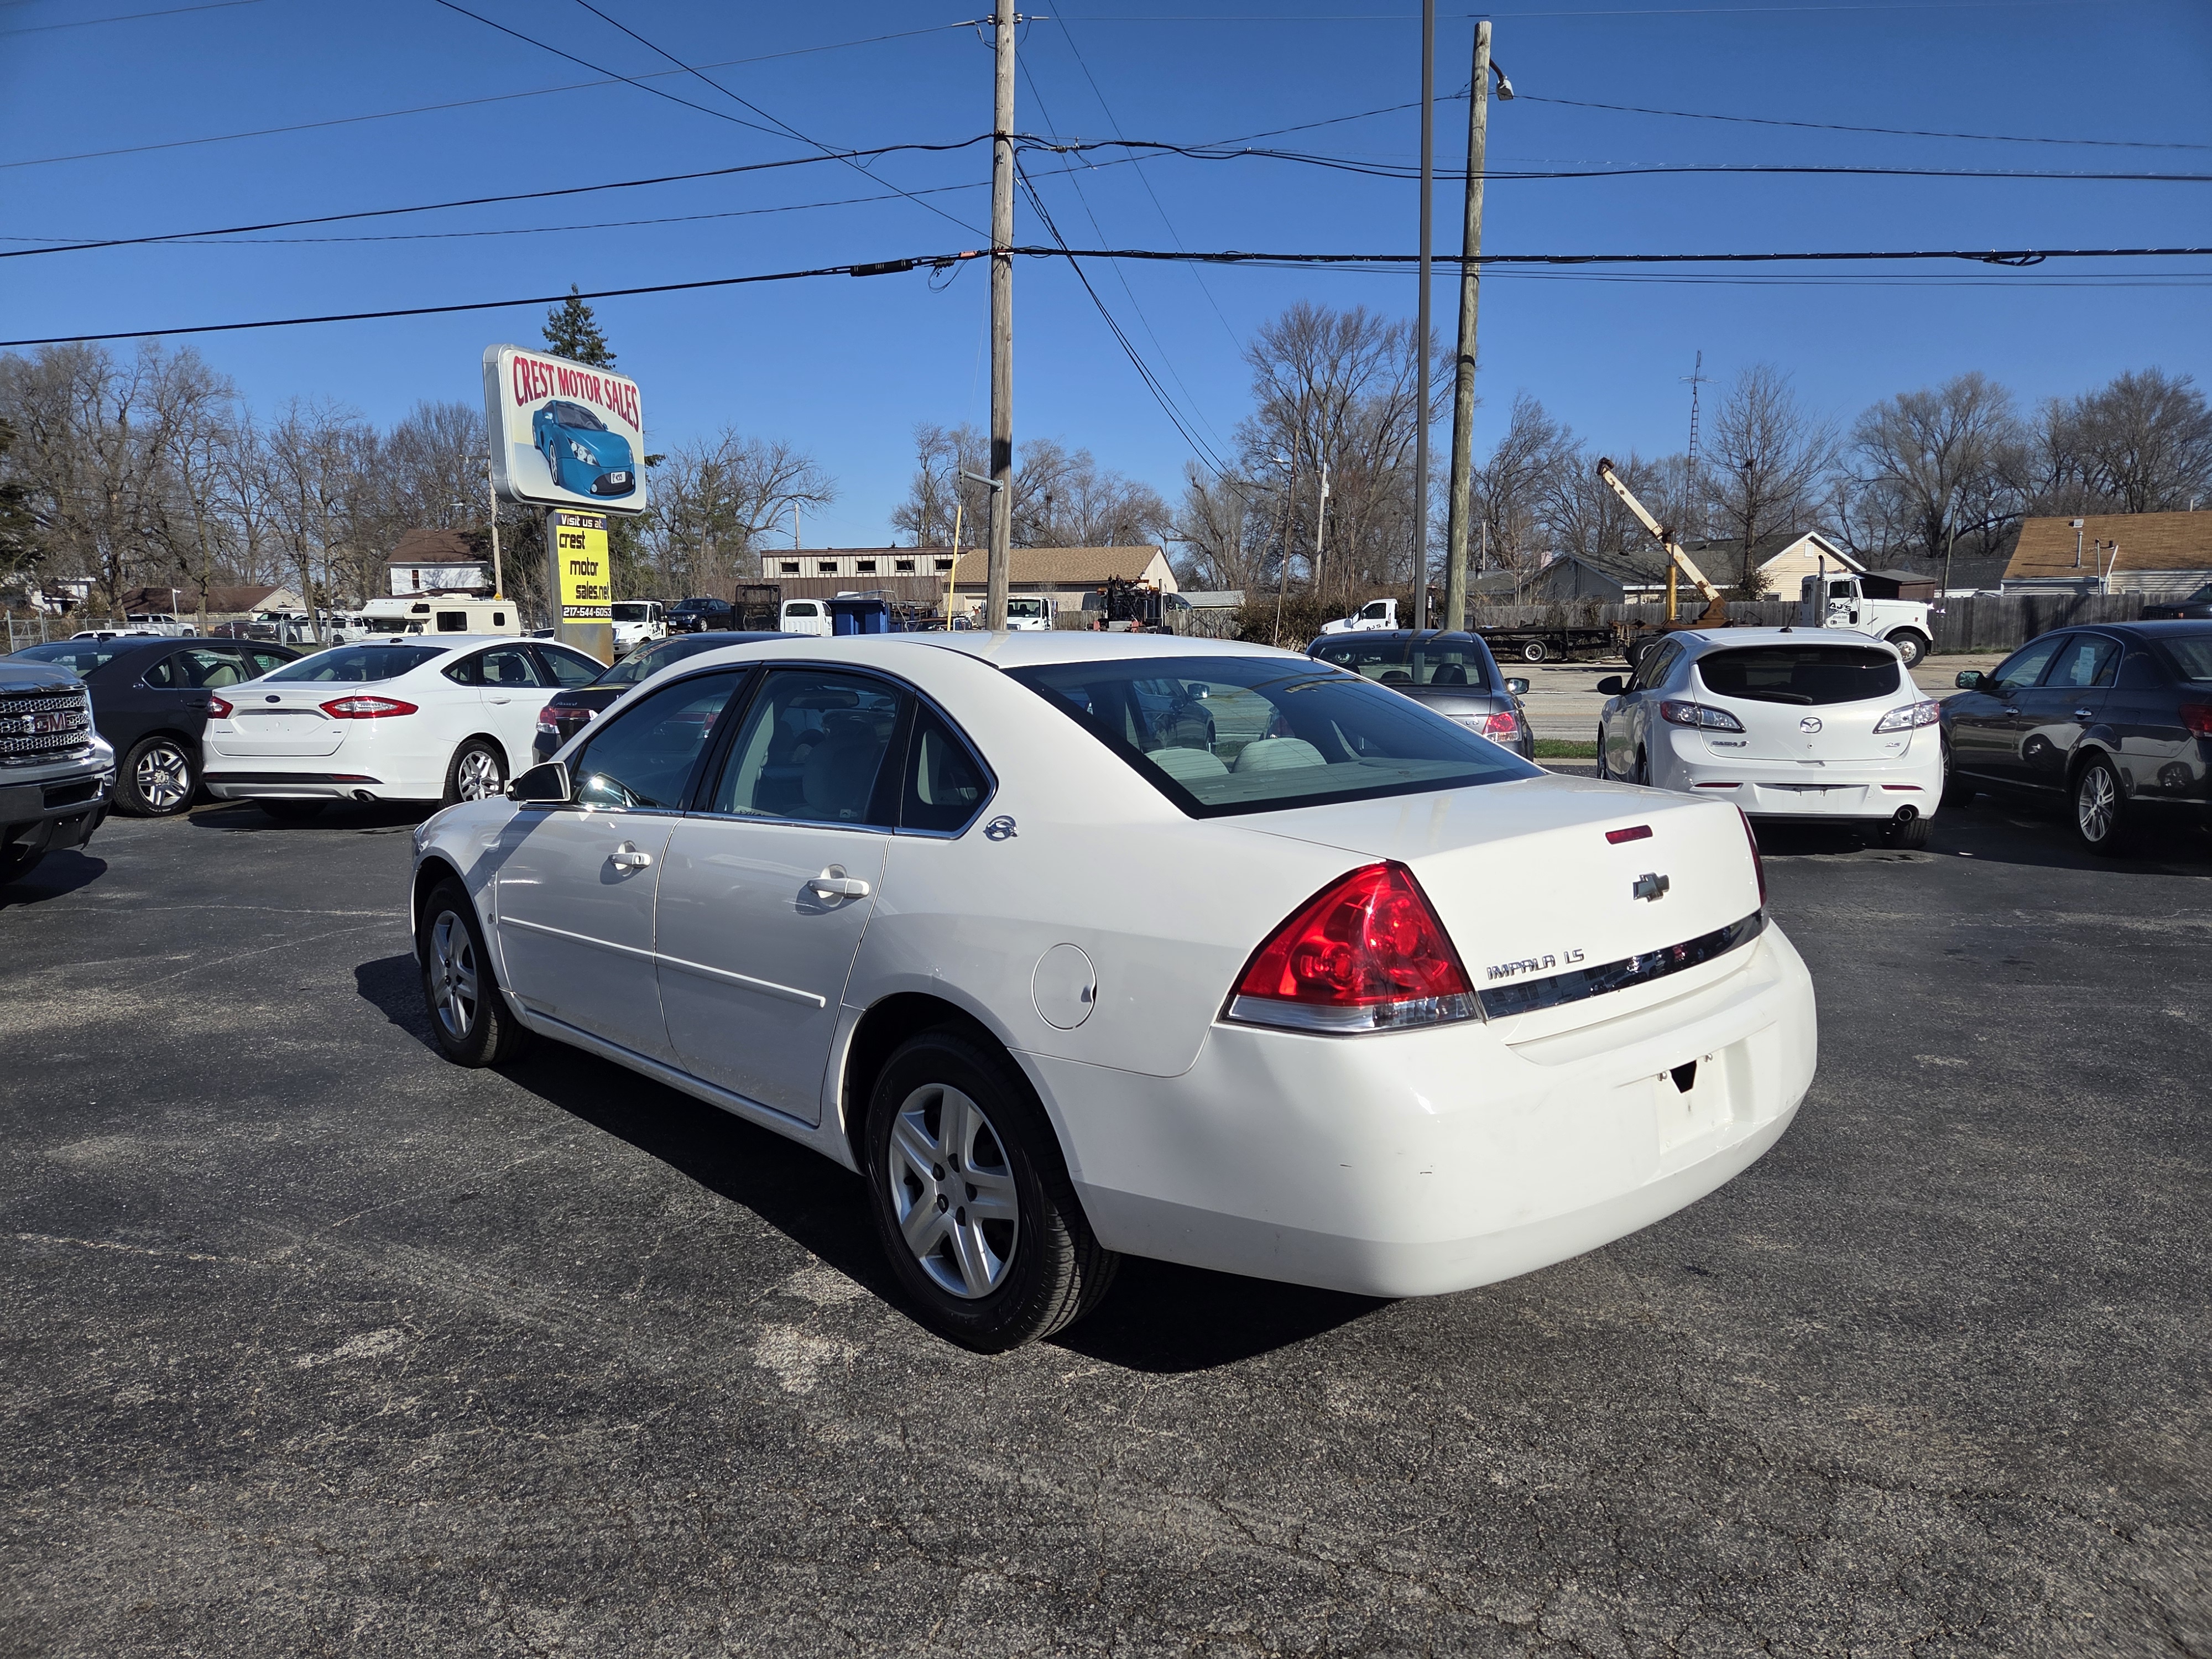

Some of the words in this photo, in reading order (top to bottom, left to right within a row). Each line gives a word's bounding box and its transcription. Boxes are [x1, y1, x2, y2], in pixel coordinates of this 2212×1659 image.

[513, 356, 555, 407] CREST
[557, 367, 603, 406] MOTOR
[604, 378, 639, 433] SALES
[561, 514, 580, 526] Visit
[582, 518, 593, 528] us
[594, 518, 603, 529] at:
[559, 530, 586, 550] crest
[570, 557, 598, 576] motor
[576, 580, 609, 600] sales.net
[563, 607, 612, 617] 217-544-6053
[34, 712, 77, 734] GMC
[1486, 954, 1556, 980] IMPALA
[1563, 948, 1585, 964] LS
